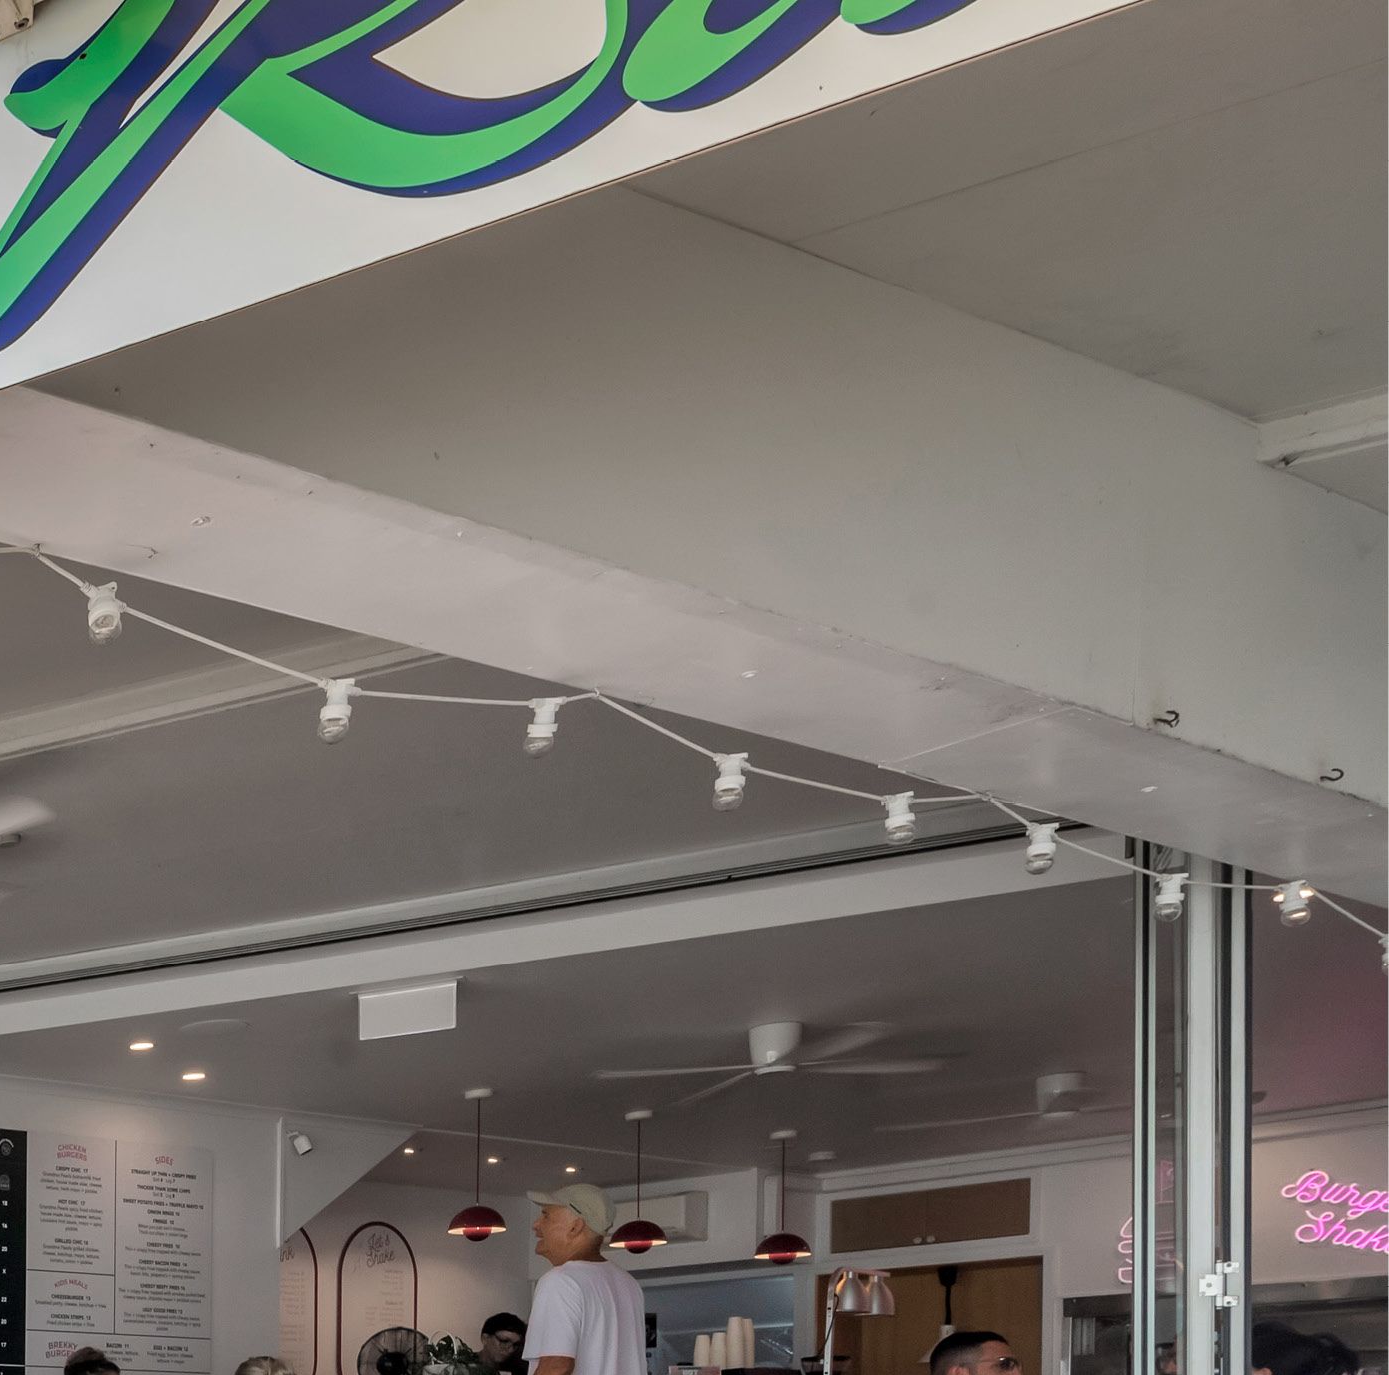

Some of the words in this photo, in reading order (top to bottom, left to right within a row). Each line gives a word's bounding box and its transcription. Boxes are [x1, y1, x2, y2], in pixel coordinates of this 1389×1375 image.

[58, 1144, 86, 1152] CHICKEN
[57, 1151, 87, 1161] BURGERS
[154, 1156, 174, 1166] SIDES
[54, 1279, 67, 1288] KIDS
[68, 1279, 88, 1290] MEALS
[48, 1341, 78, 1350] BREKKY
[45, 1350, 72, 1359] BURGE
